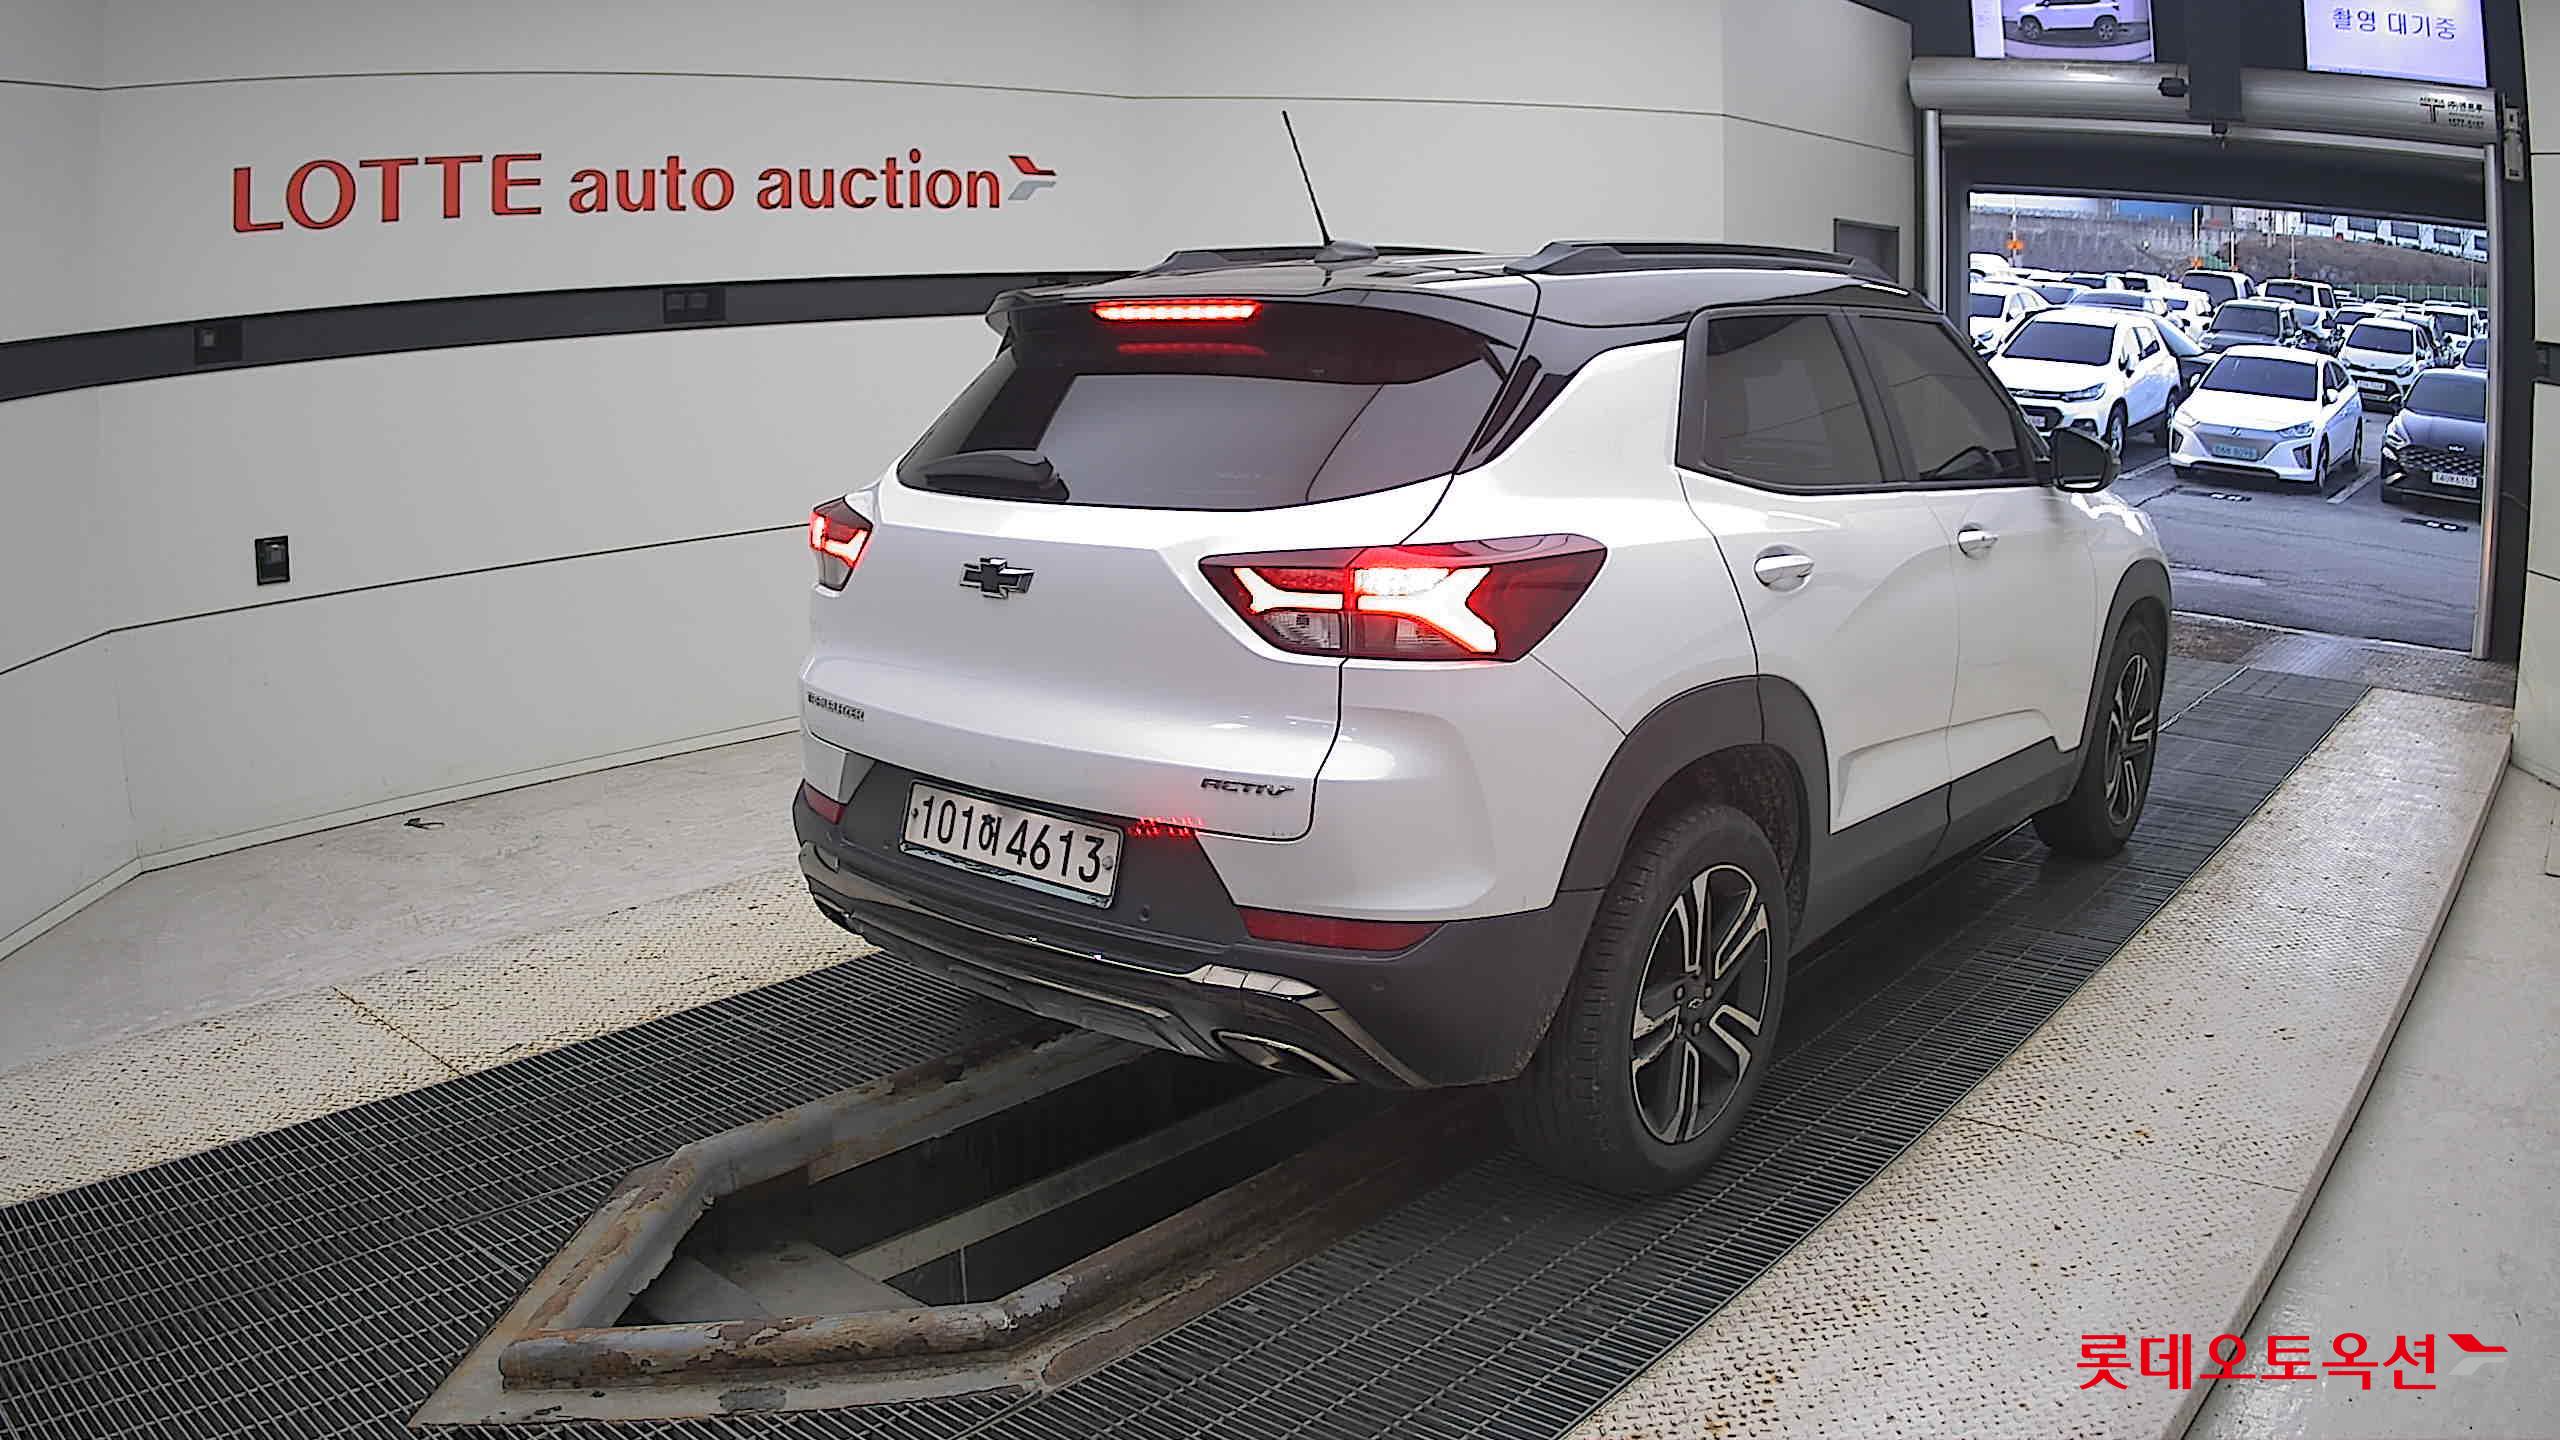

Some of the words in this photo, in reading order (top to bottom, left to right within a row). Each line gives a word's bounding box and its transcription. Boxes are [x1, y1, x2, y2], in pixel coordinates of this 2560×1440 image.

[2333, 7, 2376, 32] 촬영
[2387, 12, 2457, 40] 대기중
[233, 152, 542, 233] LOTTE
[568, 155, 736, 213] auto
[757, 149, 1002, 209] auction
[1201, 777, 1297, 798] ACTIV
